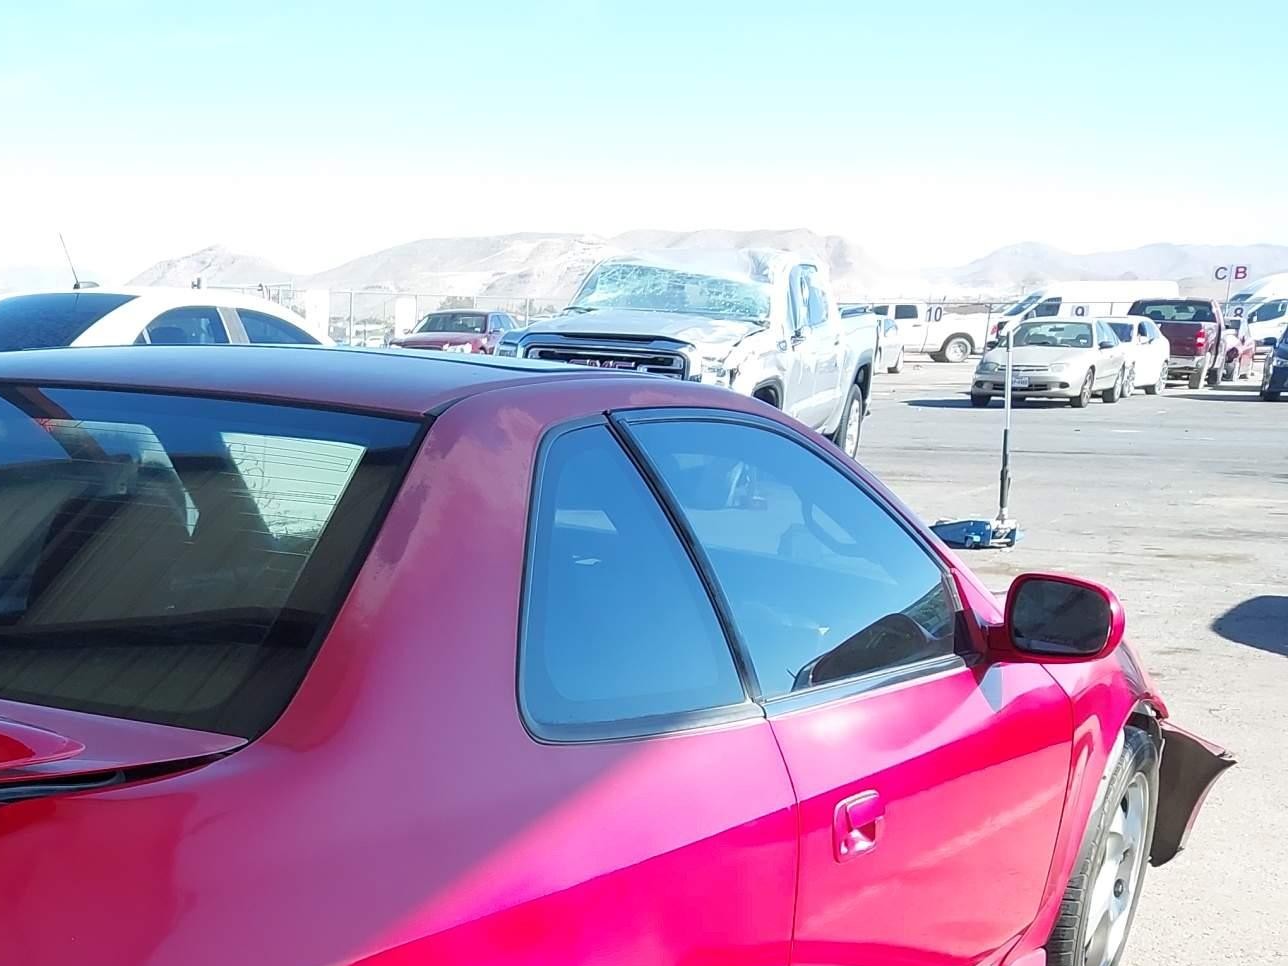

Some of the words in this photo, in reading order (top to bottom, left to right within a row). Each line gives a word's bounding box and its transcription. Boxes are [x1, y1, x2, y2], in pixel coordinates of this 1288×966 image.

[1215, 266, 1228, 280] C
[1234, 266, 1248, 280] B
[926, 306, 943, 322] 10
